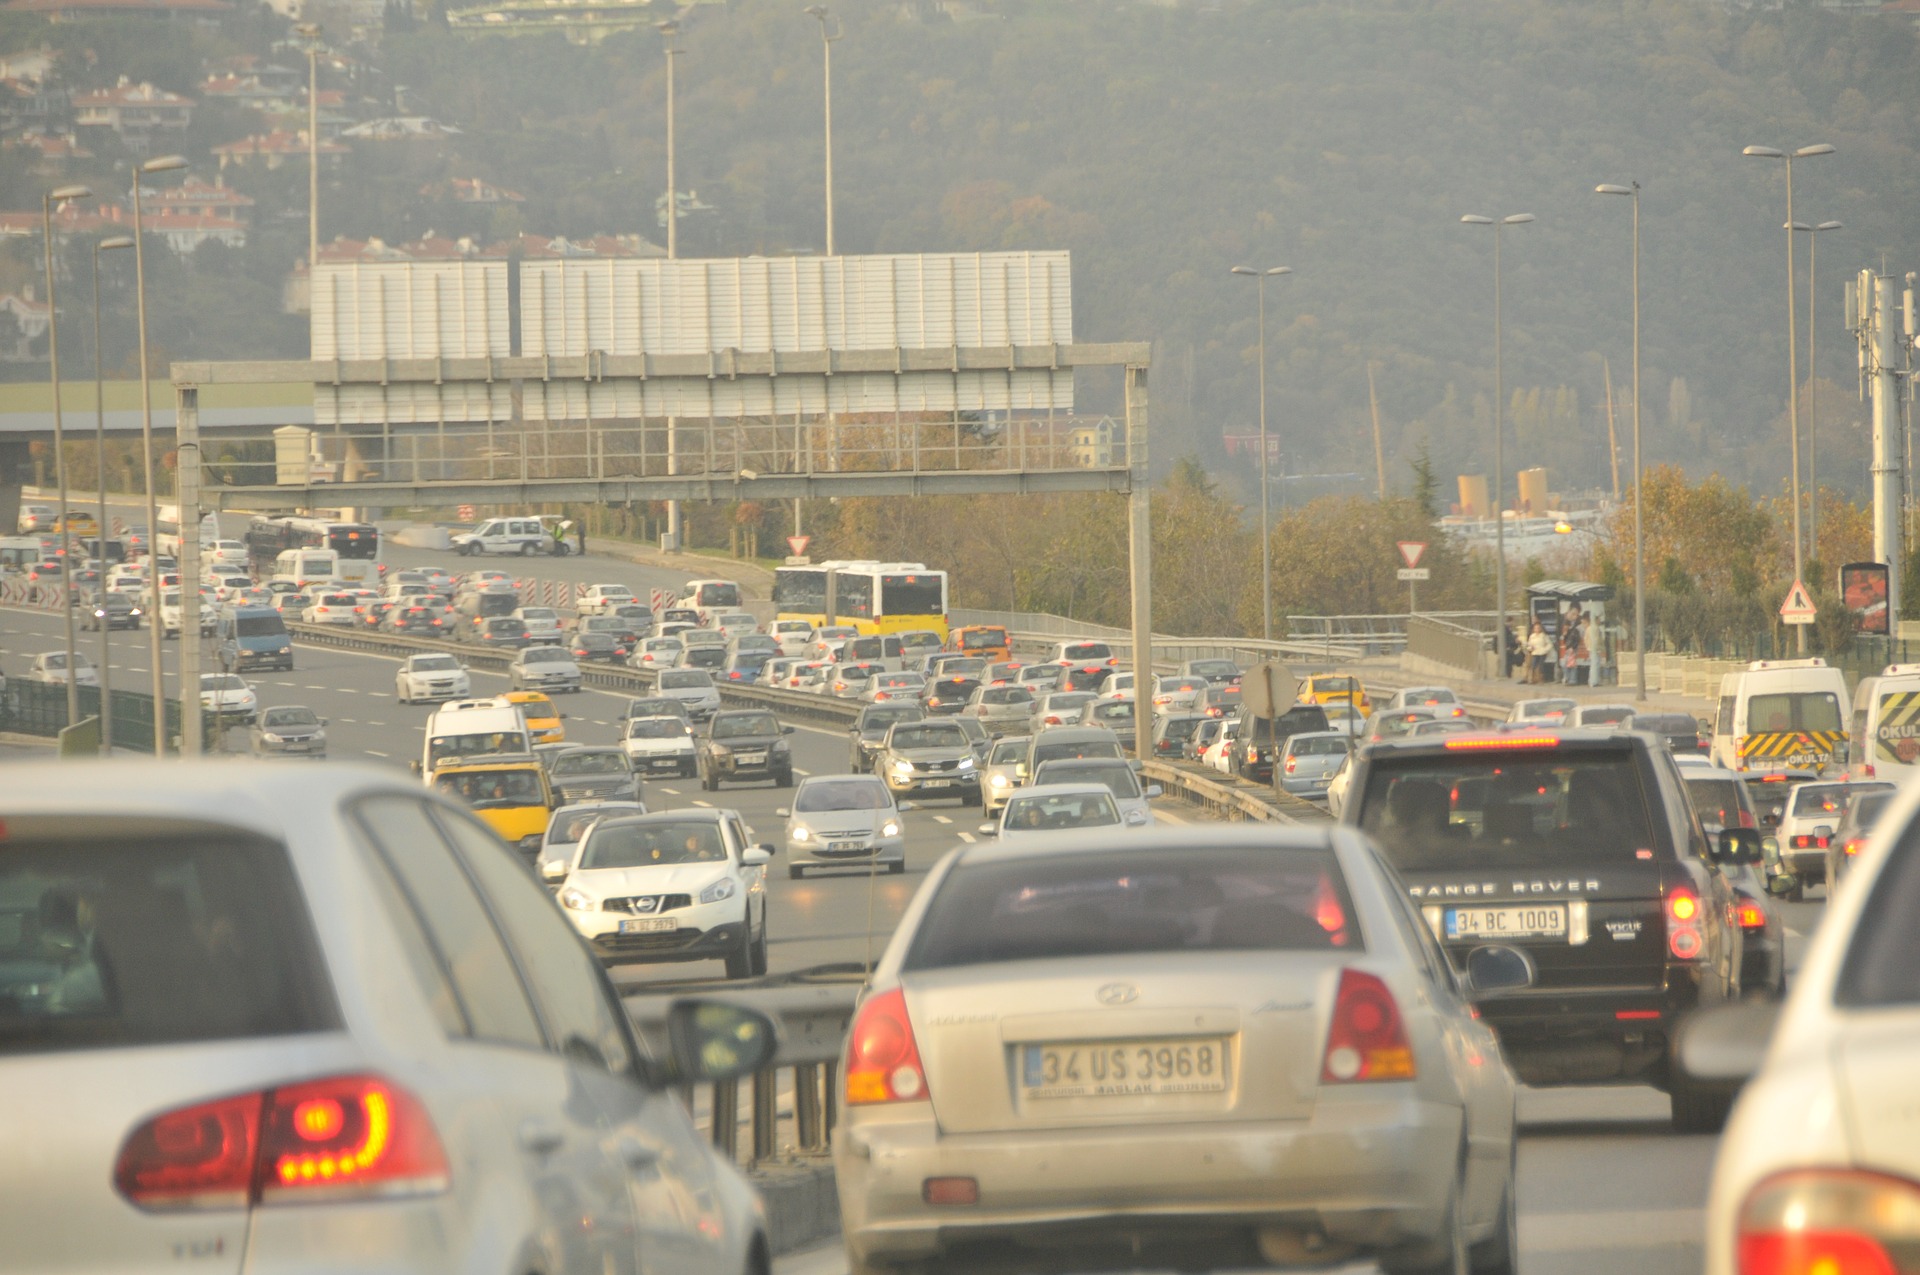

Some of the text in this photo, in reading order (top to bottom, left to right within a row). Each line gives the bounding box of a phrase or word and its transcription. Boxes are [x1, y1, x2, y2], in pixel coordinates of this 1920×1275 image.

[1879, 725, 1920, 739] OKUL
[1789, 754, 1817, 764] OKUL
[1409, 880, 1600, 897] RANGE ROVER
[1457, 910, 1560, 932] 34 BC 1009
[1605, 920, 1642, 932] VOGUE
[1043, 1045, 1214, 1084] 34 US 3968
[1094, 1084, 1152, 1096] MASLAK
